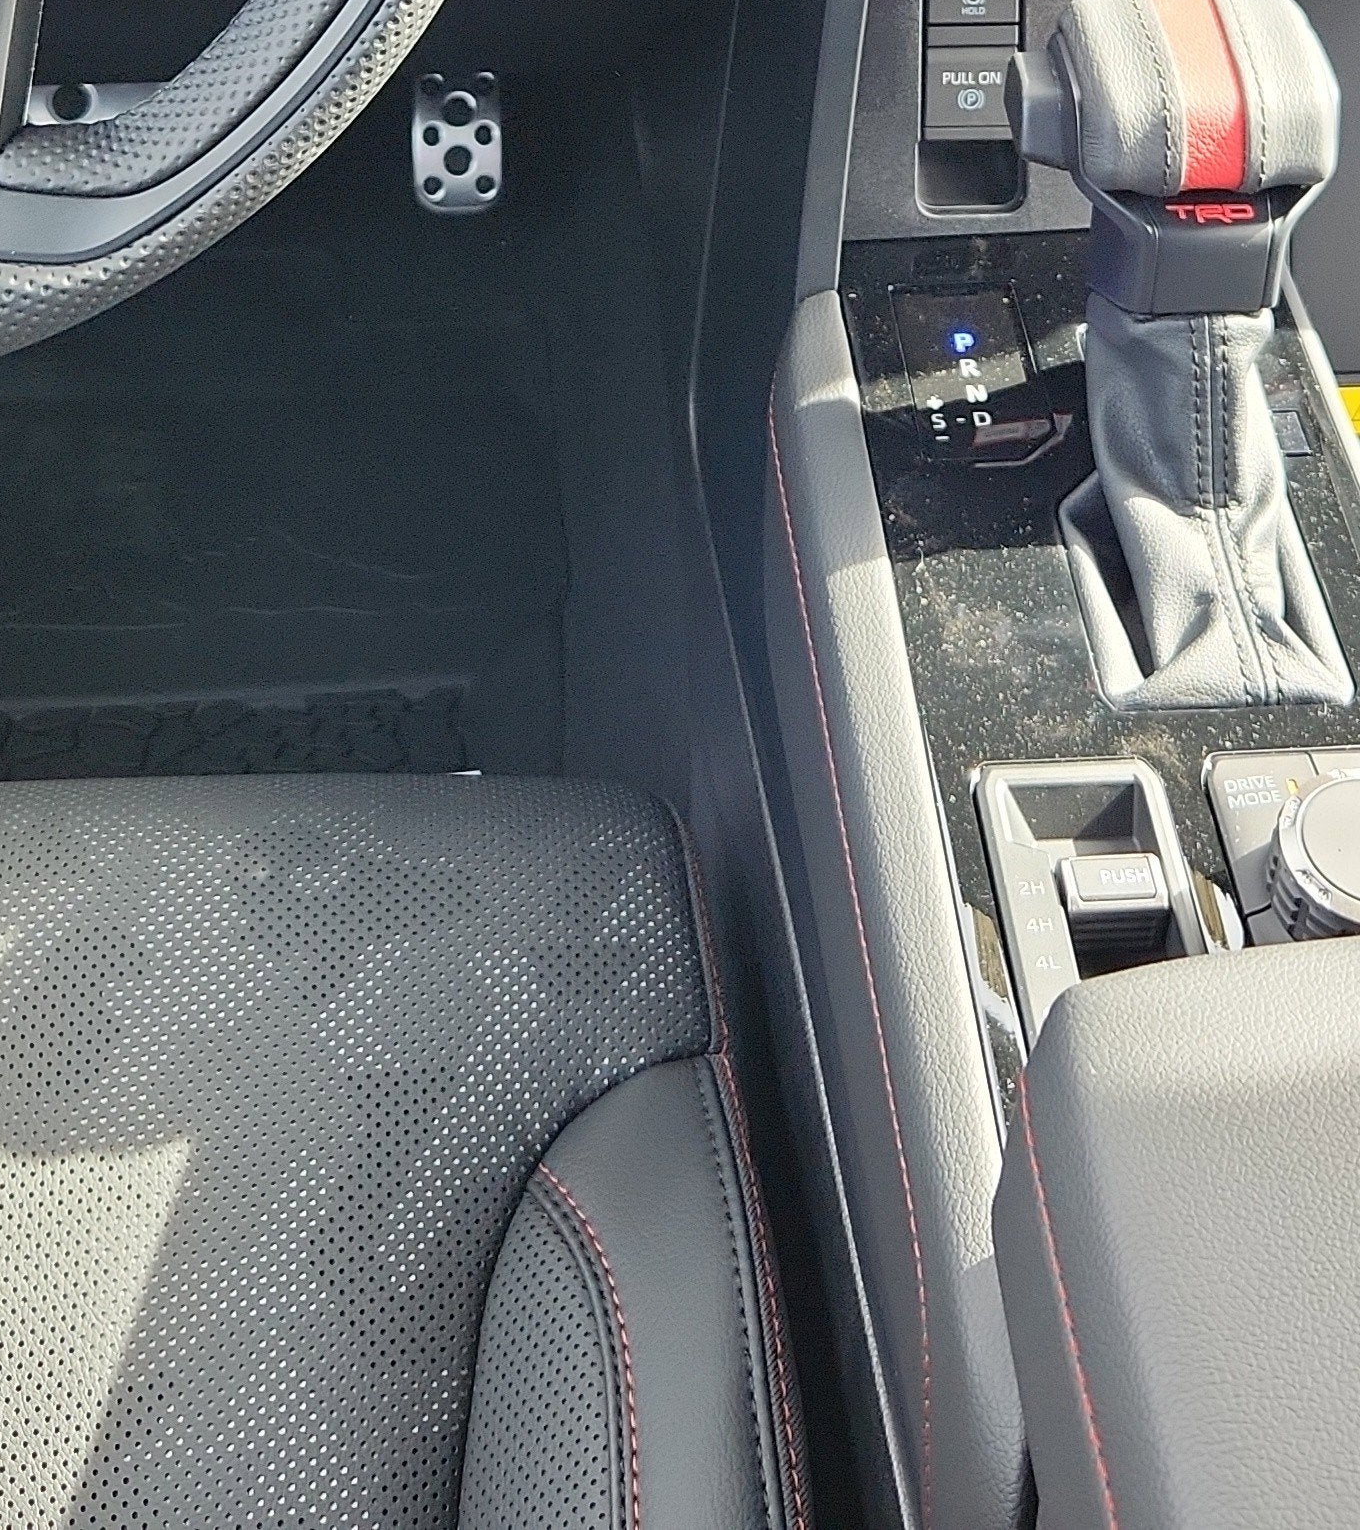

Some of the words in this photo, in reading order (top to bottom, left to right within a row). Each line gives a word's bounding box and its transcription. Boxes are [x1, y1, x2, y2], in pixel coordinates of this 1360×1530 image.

[960, 6, 986, 16] HOLD
[941, 70, 976, 86] PULL
[978, 70, 1002, 86] ON
[1164, 202, 1255, 225] TRD
[953, 332, 975, 353] P
[959, 358, 982, 379] R
[965, 383, 989, 404] N
[930, 412, 948, 431] S
[972, 411, 993, 428] D
[1223, 774, 1278, 794] DRIVE
[1227, 789, 1285, 810] MODE
[1098, 867, 1152, 886] PUSH
[1018, 880, 1047, 897] 2H
[1026, 917, 1055, 933] 4H
[1035, 954, 1063, 971] 4L
